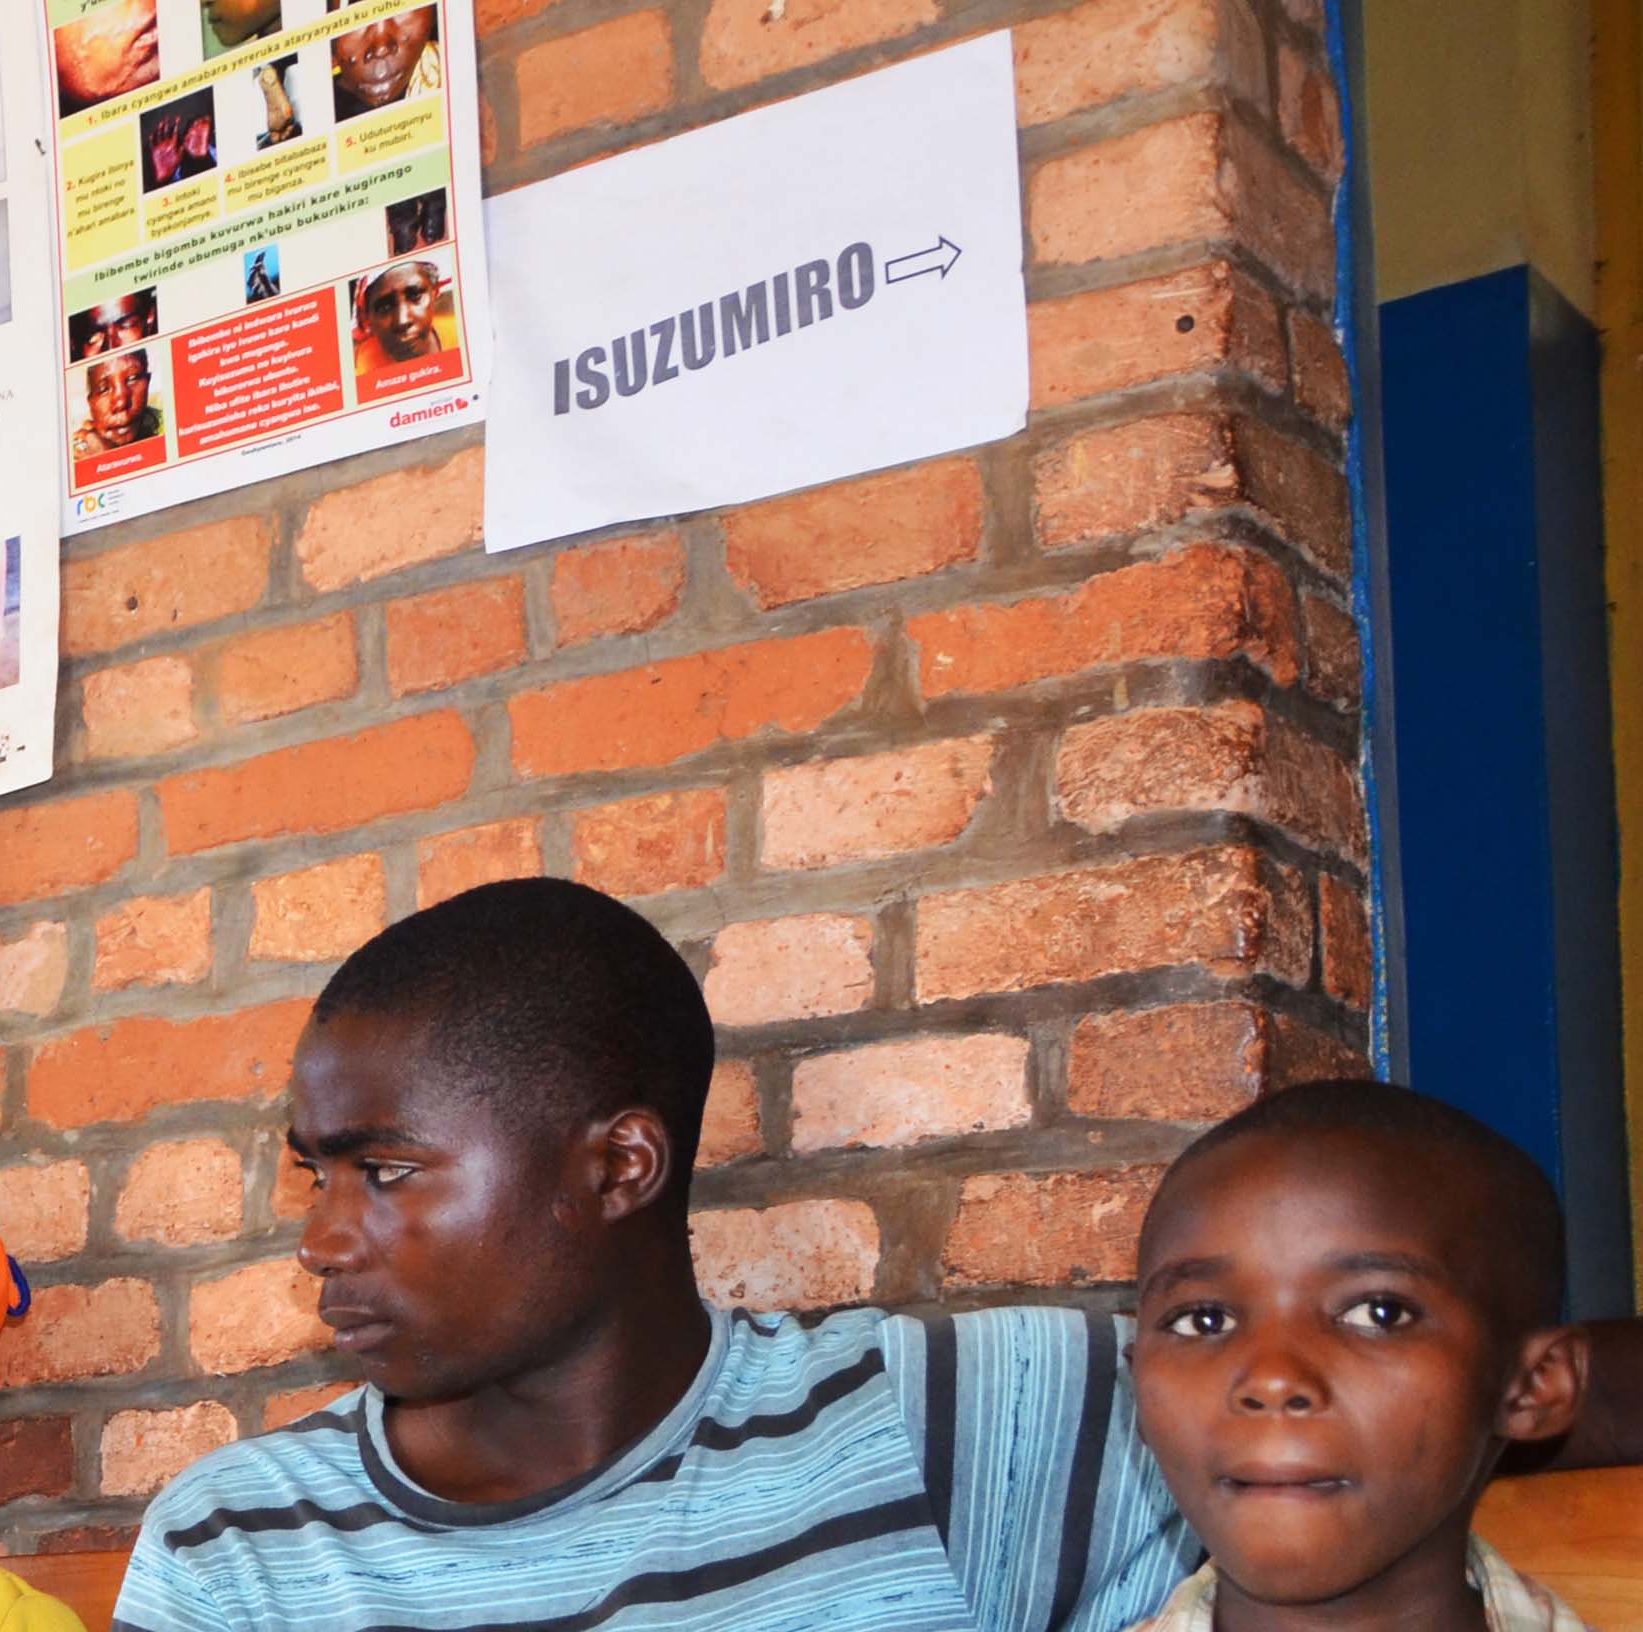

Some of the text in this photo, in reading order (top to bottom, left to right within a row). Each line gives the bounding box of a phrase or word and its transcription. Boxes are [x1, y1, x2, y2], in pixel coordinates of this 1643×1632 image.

[100, 102, 128, 121] Ibara
[130, 84, 178, 112] cyangwa
[181, 64, 229, 89] amabara
[231, 44, 281, 72] yereruka
[354, 9, 370, 24] ku
[94, 164, 414, 284] Ibibembe bigomba kuvurwa hakiri kare kugirango
[133, 261, 184, 286] twirinde
[187, 240, 246, 267] ubumuga
[553, 241, 875, 416] ISUZUMIRO
[390, 403, 455, 429] damien
